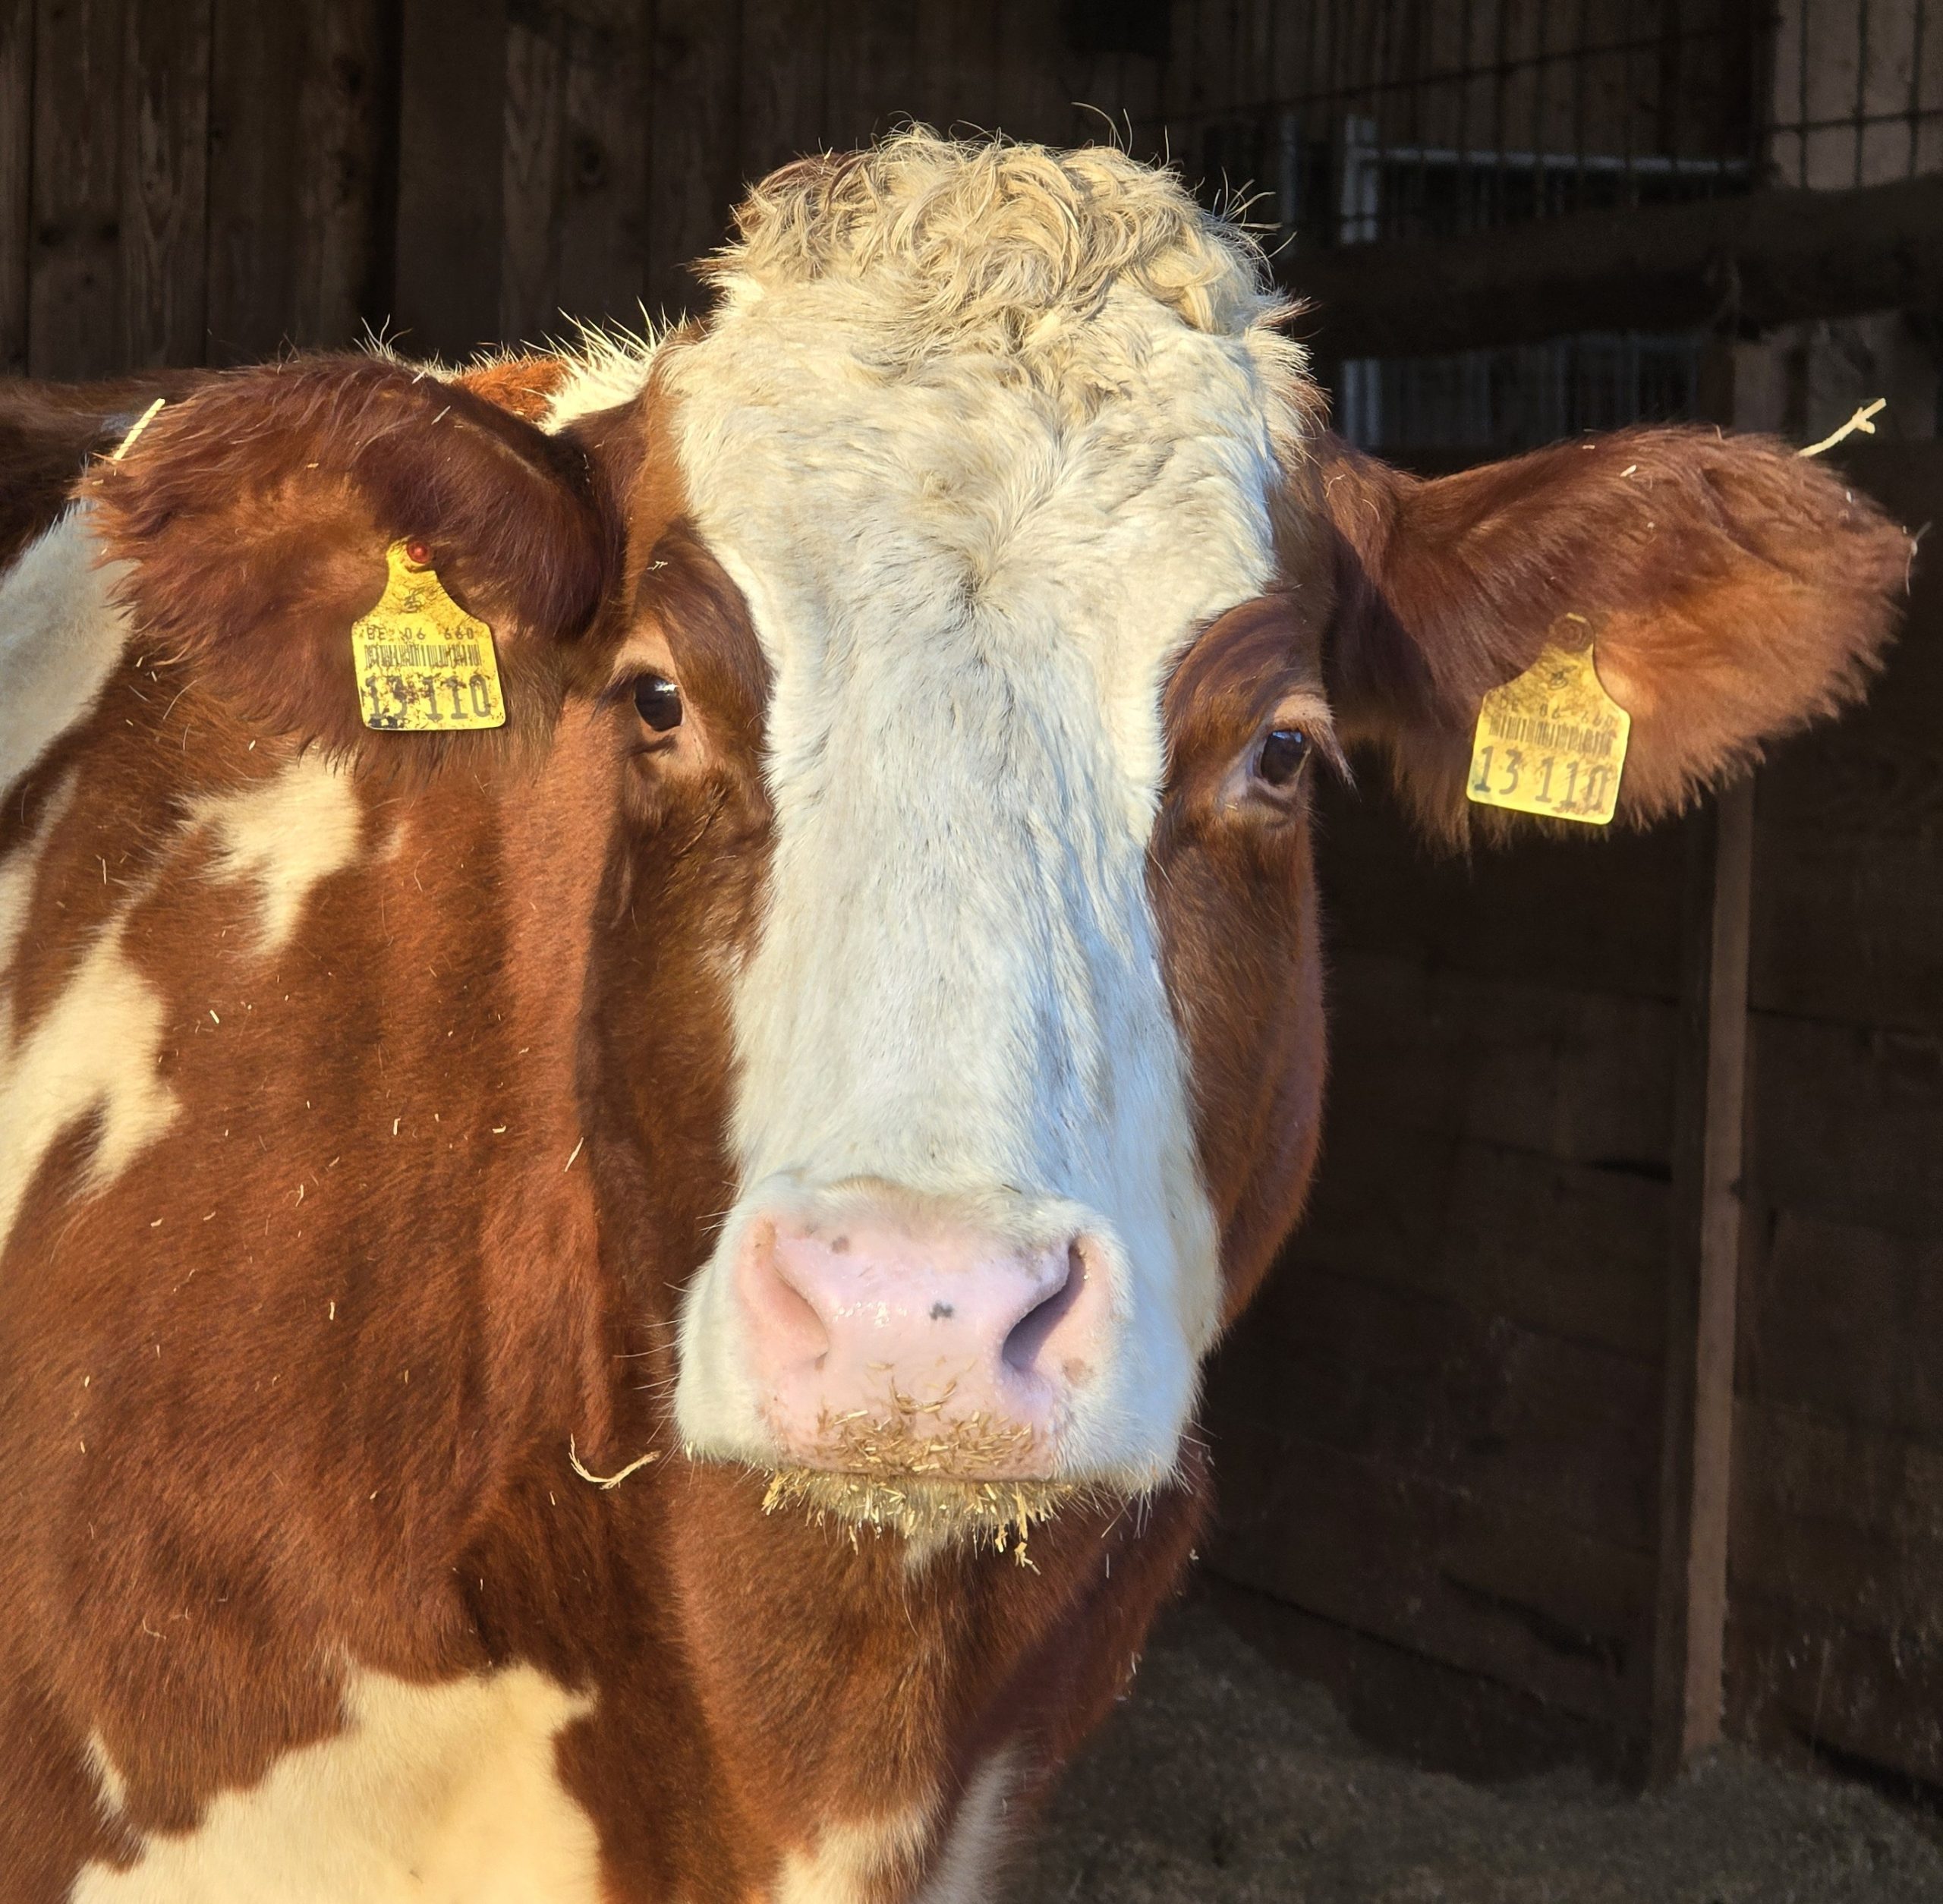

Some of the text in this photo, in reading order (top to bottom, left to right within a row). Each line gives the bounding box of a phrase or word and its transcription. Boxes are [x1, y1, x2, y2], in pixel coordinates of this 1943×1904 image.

[404, 627, 426, 640] 06
[444, 627, 474, 640] 660
[422, 674, 492, 722] 110
[1474, 745, 1613, 810] 13 110
